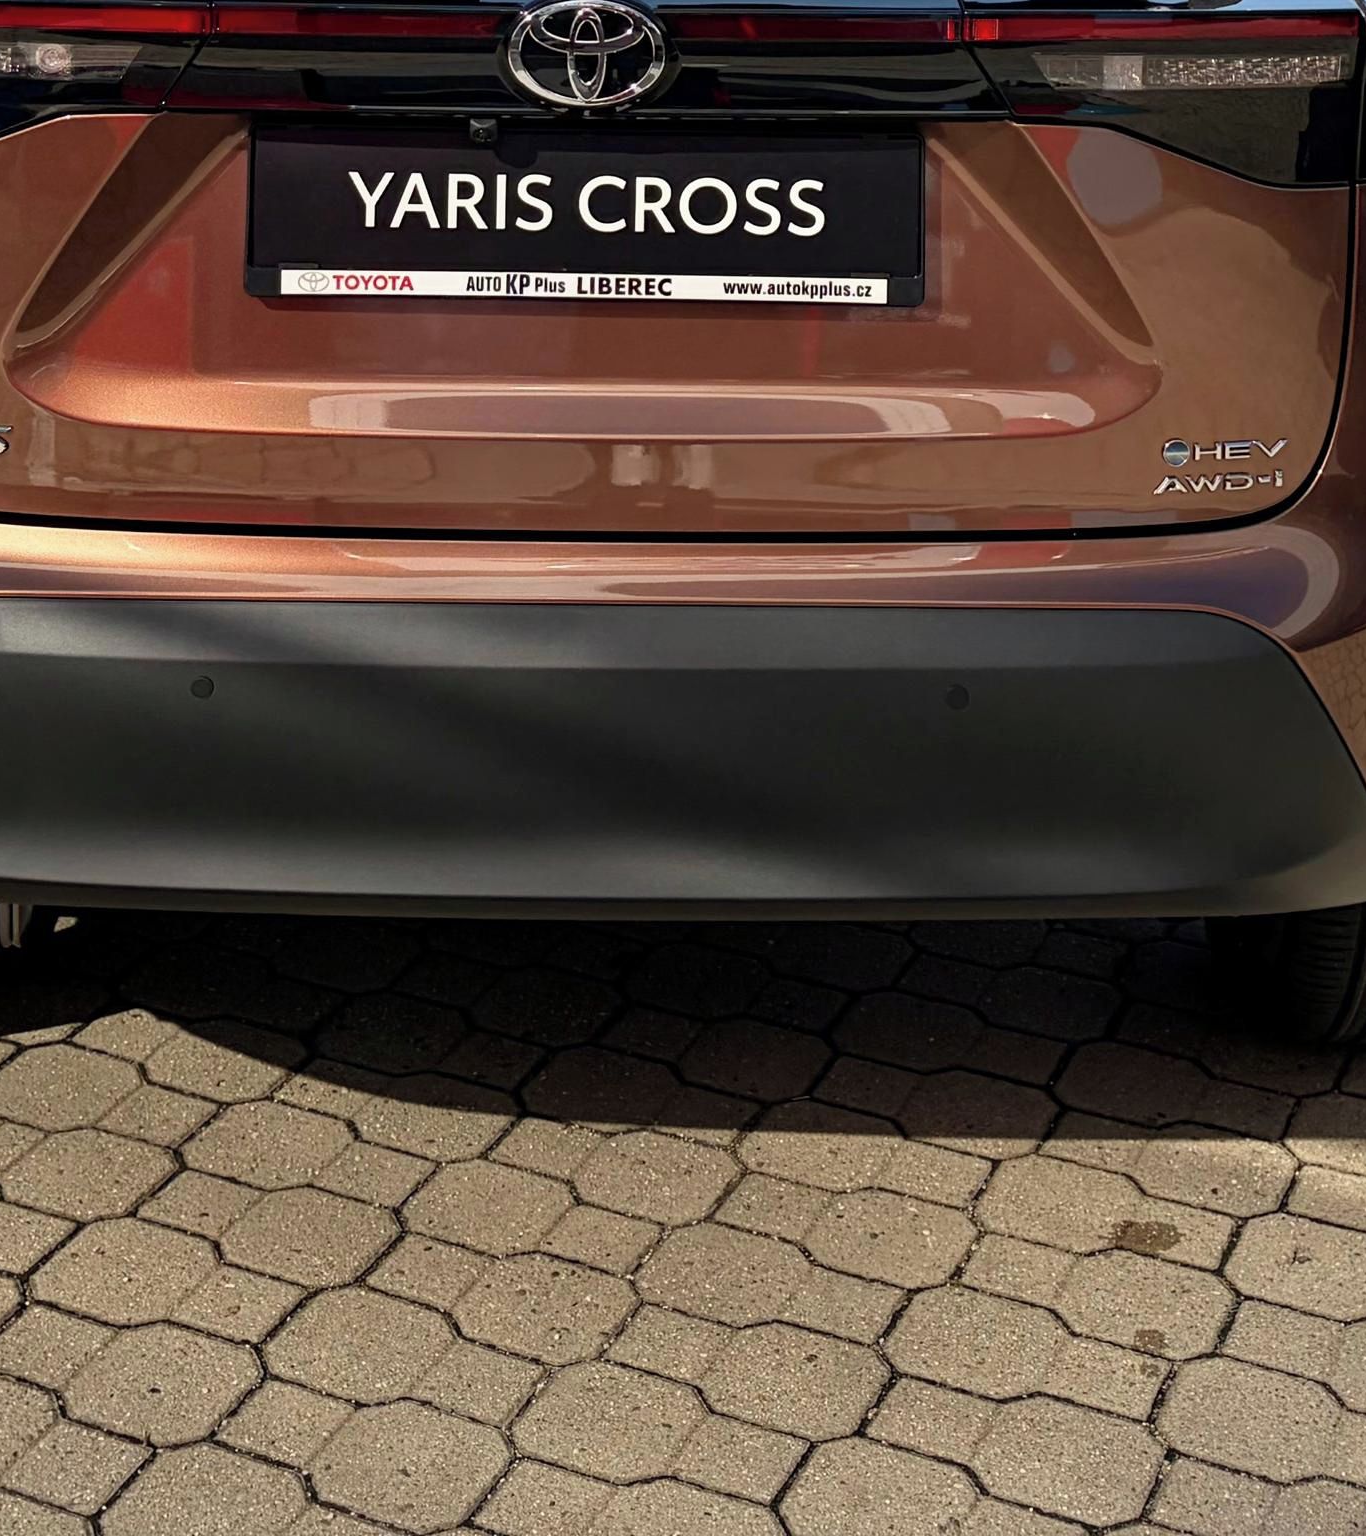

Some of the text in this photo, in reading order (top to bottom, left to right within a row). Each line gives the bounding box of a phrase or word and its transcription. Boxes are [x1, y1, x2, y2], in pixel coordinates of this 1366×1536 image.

[348, 171, 827, 238] YARIS CROSS
[333, 273, 873, 300] TOYOTA AUTO KP Plus LIBEREC www.autokpplus.cz
[1193, 438, 1289, 462] HEV
